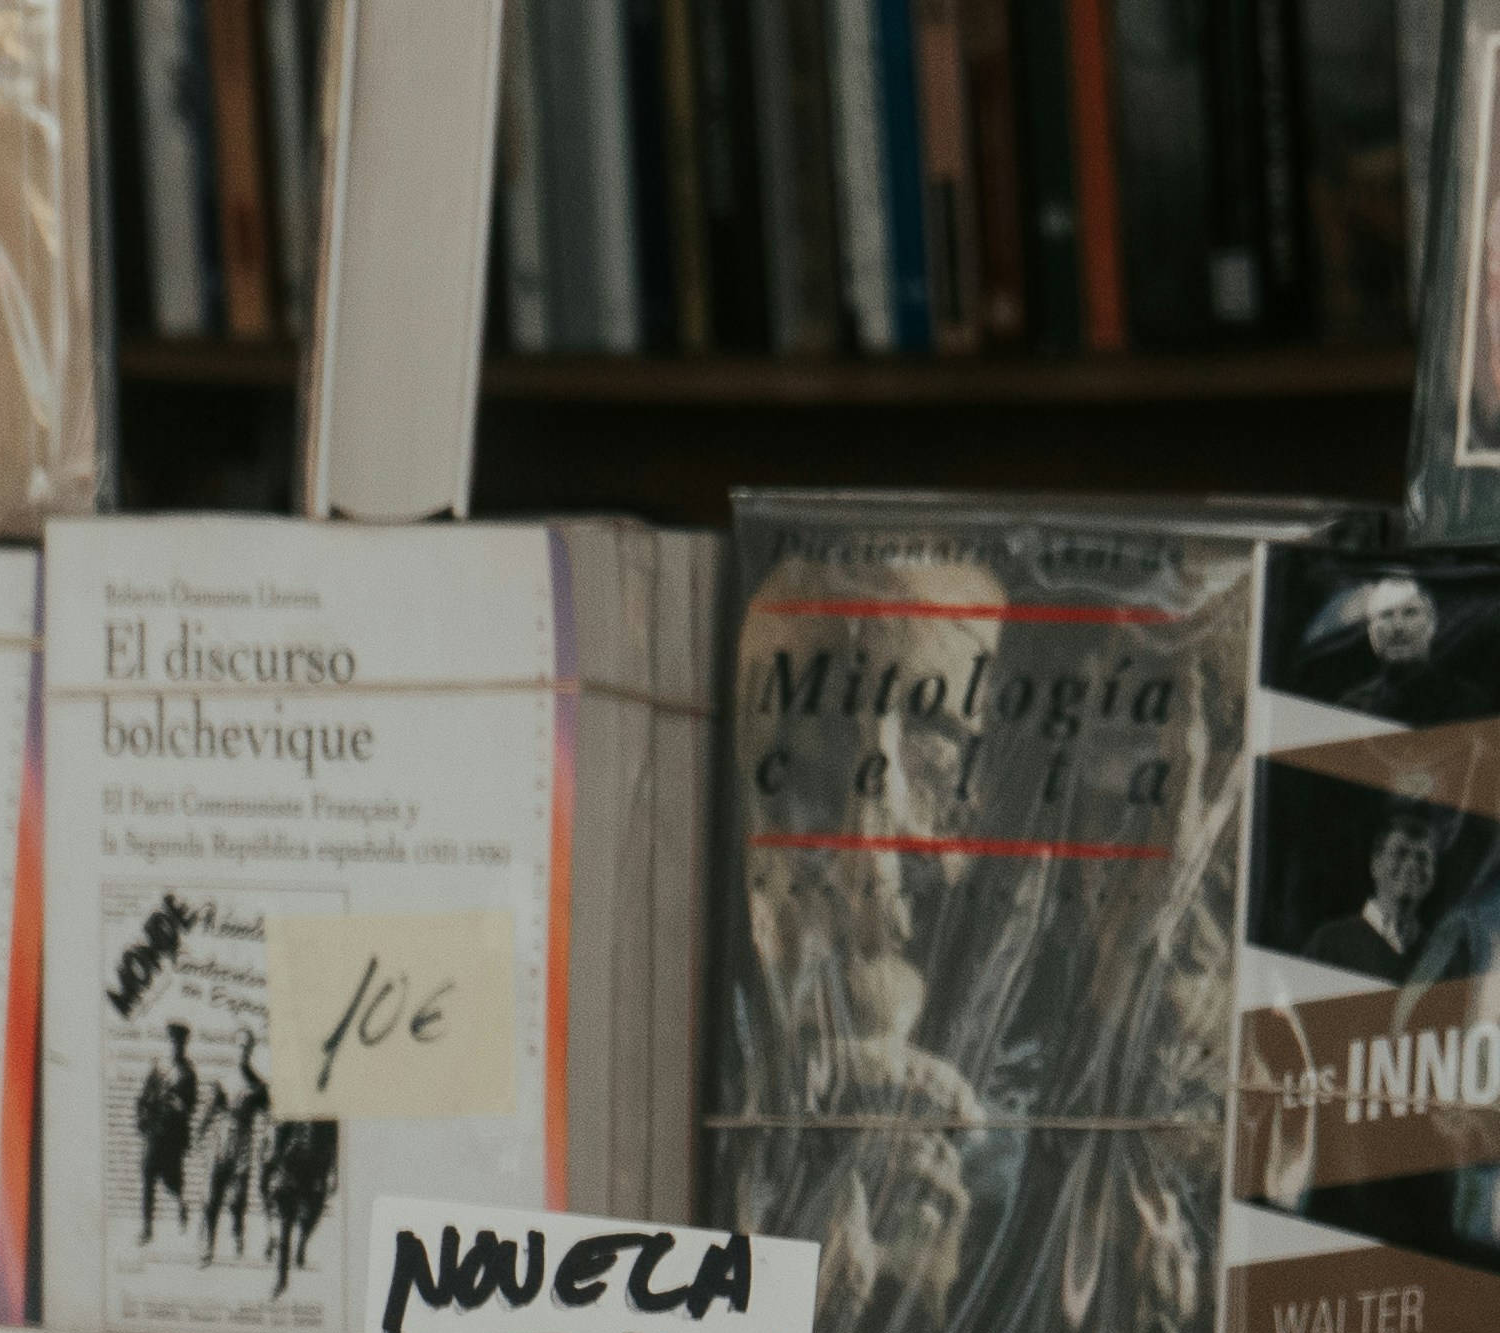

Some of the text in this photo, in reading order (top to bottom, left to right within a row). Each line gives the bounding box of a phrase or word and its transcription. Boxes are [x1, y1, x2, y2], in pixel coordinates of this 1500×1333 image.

[104, 616, 357, 685] El discurso
[760, 648, 1174, 740] Mitología
[102, 690, 374, 779] bolchevique
[756, 738, 1168, 804] celta
[316, 952, 457, 1093] 10€
[1282, 1063, 1337, 1109] LOS
